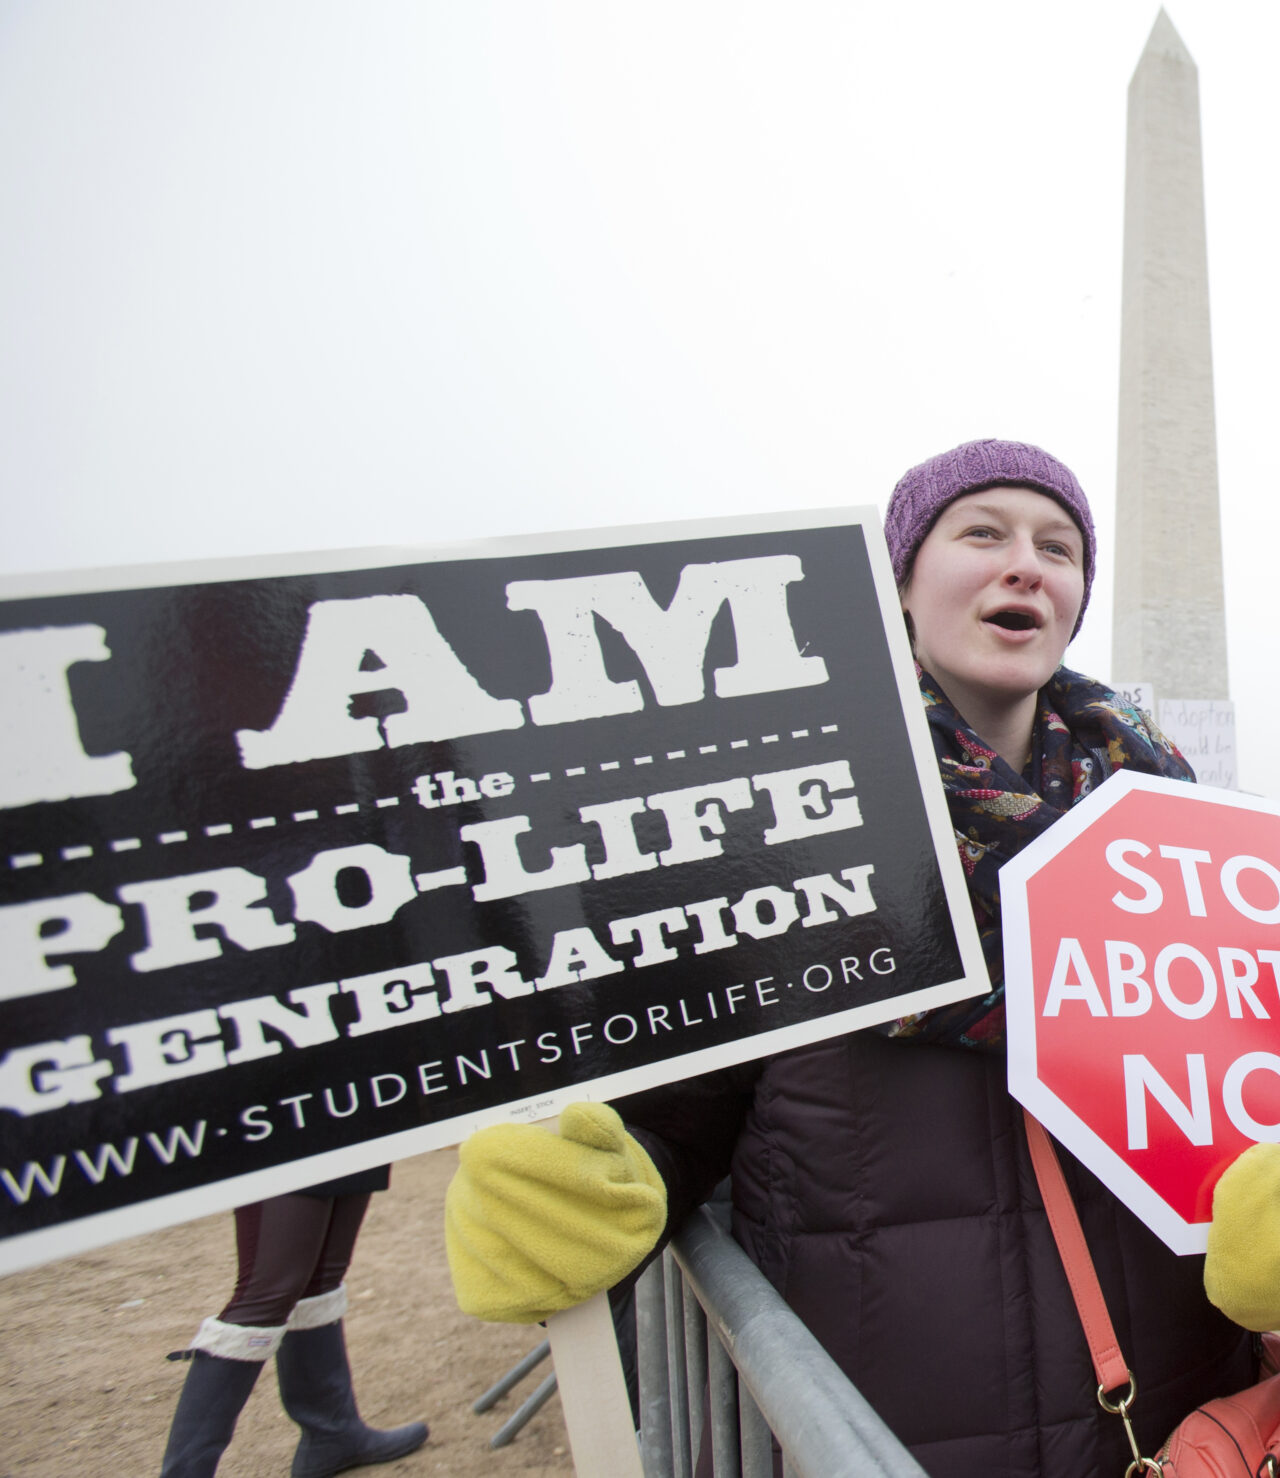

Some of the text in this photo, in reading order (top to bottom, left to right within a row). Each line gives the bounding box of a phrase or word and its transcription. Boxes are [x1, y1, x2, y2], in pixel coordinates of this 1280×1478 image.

[0, 554, 830, 808] I AM
[411, 771, 516, 809] the
[0, 760, 863, 1000] PRO-LIFE
[0, 864, 877, 1115] GENERATION
